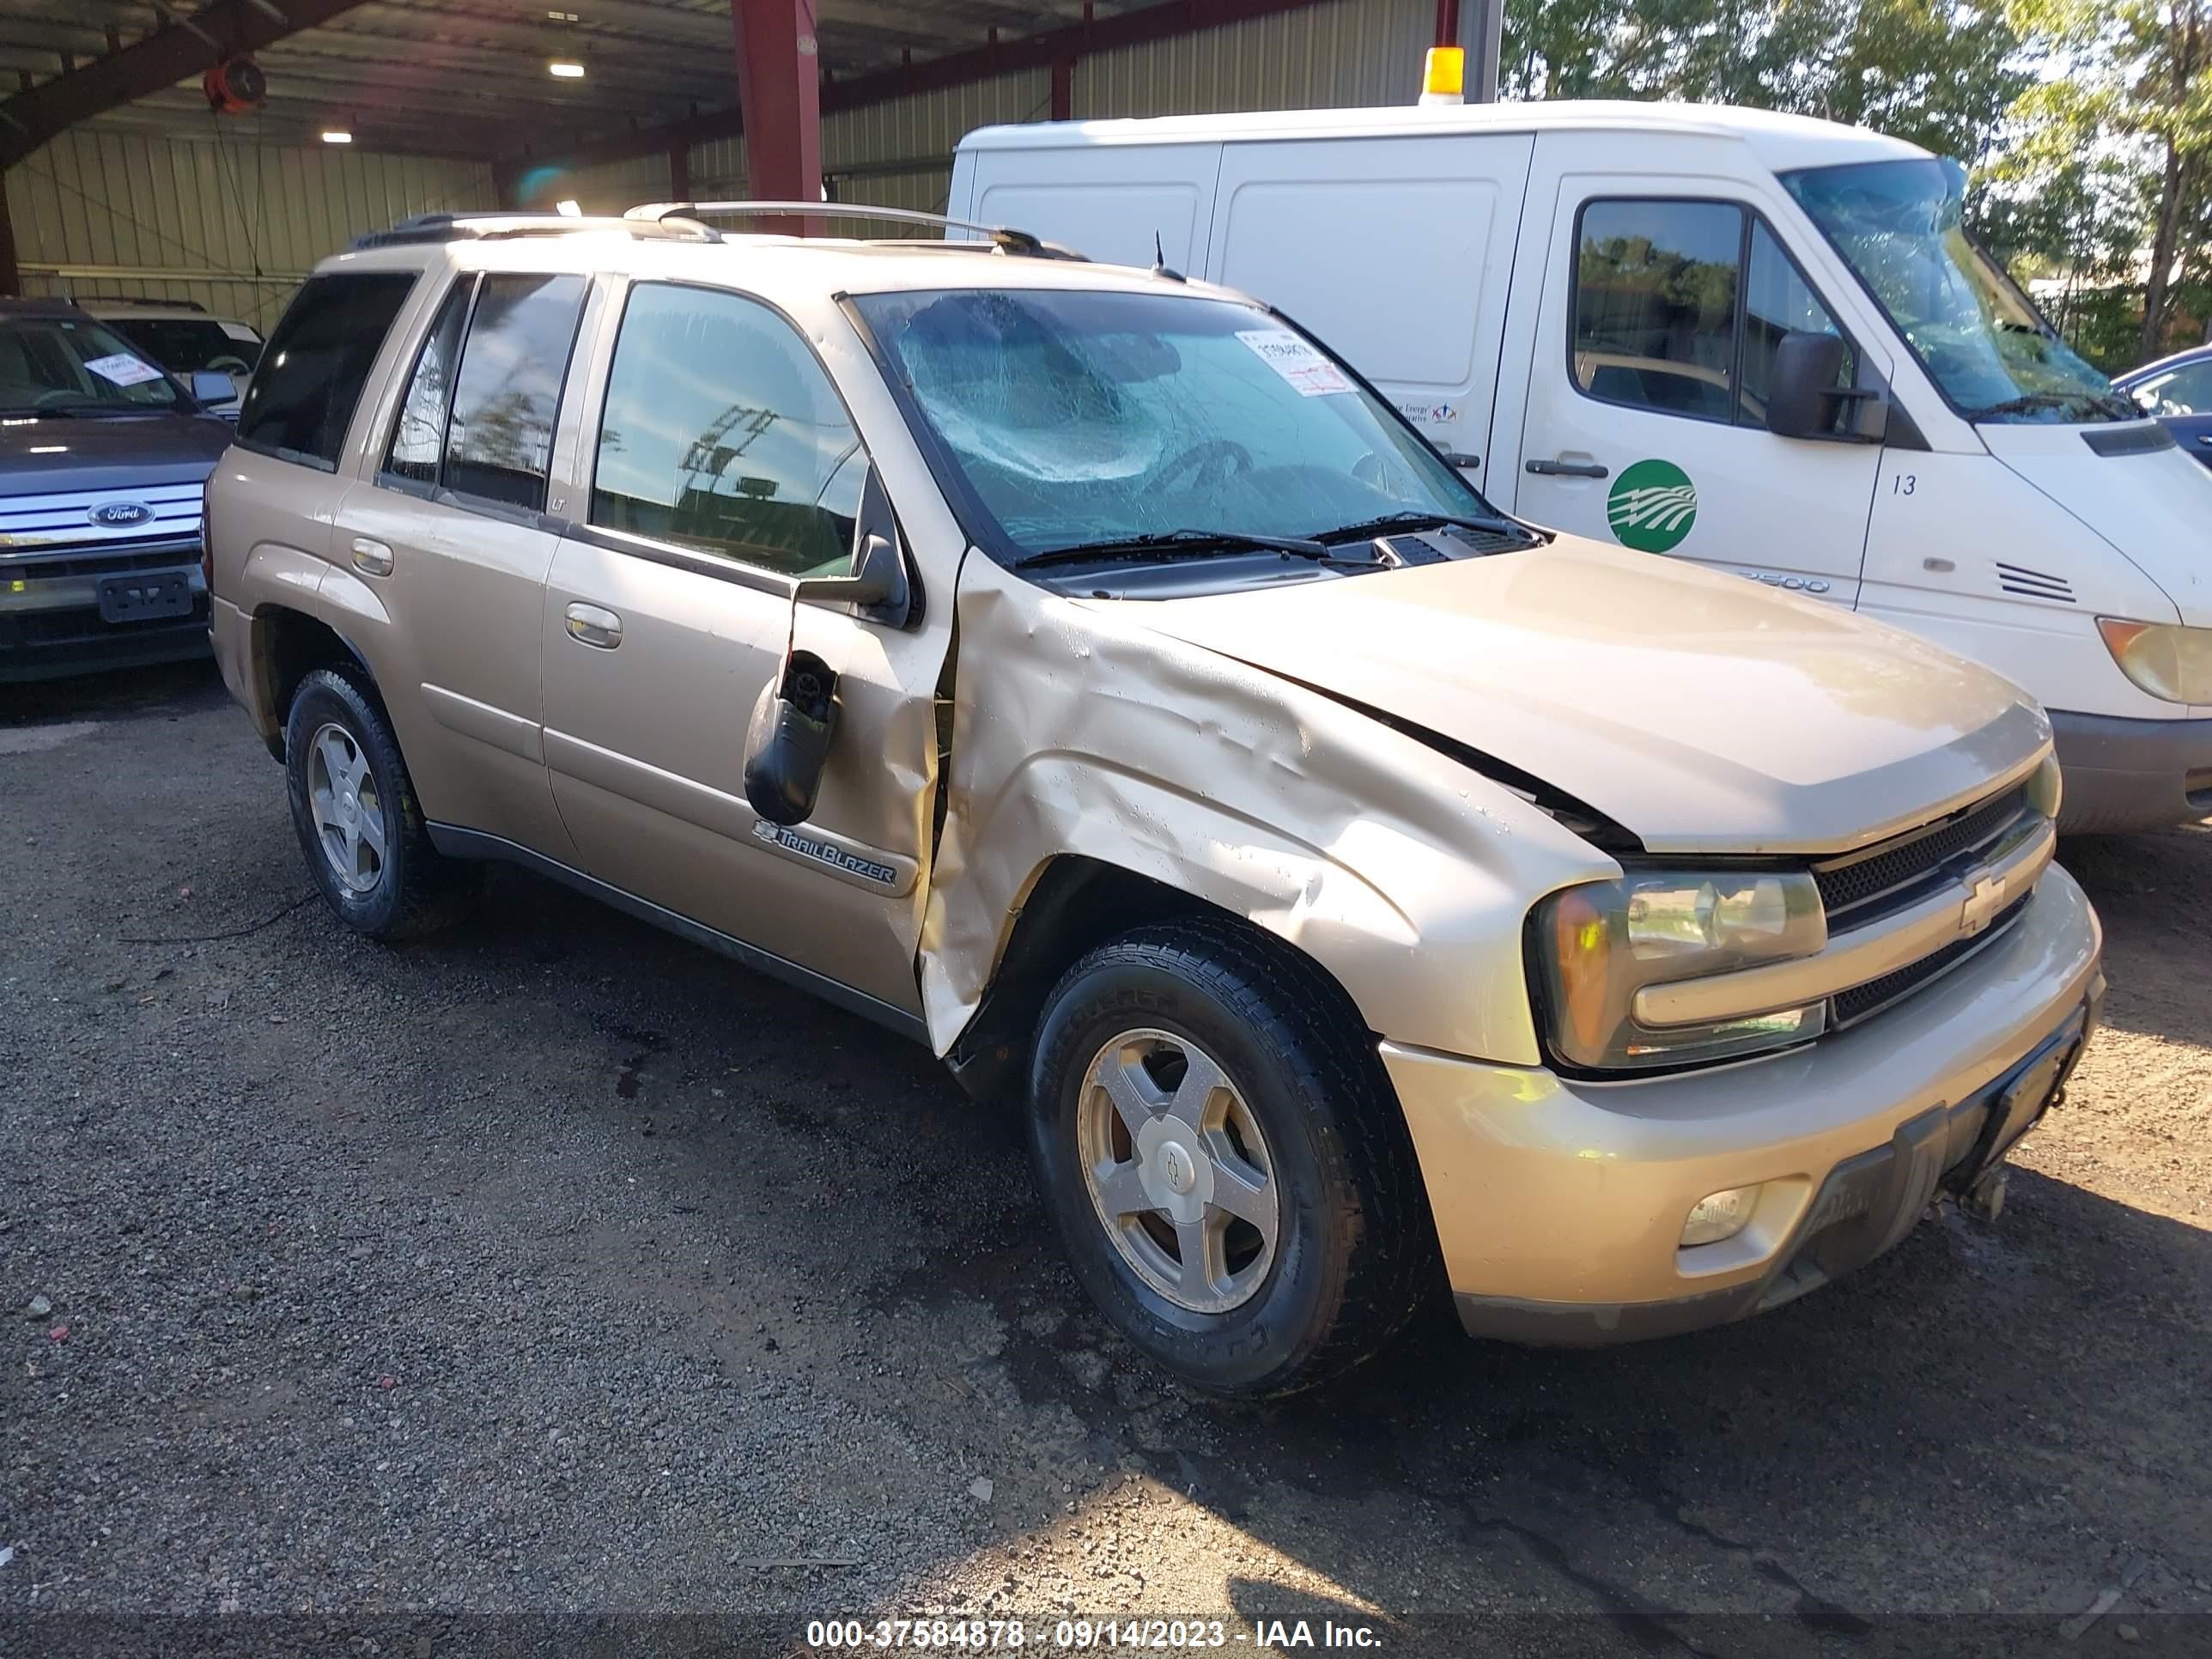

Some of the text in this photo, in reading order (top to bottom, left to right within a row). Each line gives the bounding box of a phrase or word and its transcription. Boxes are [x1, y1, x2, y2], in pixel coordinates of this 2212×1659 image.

[1893, 474, 1916, 495] 13
[107, 504, 139, 520] Ford
[551, 498, 566, 513] LT
